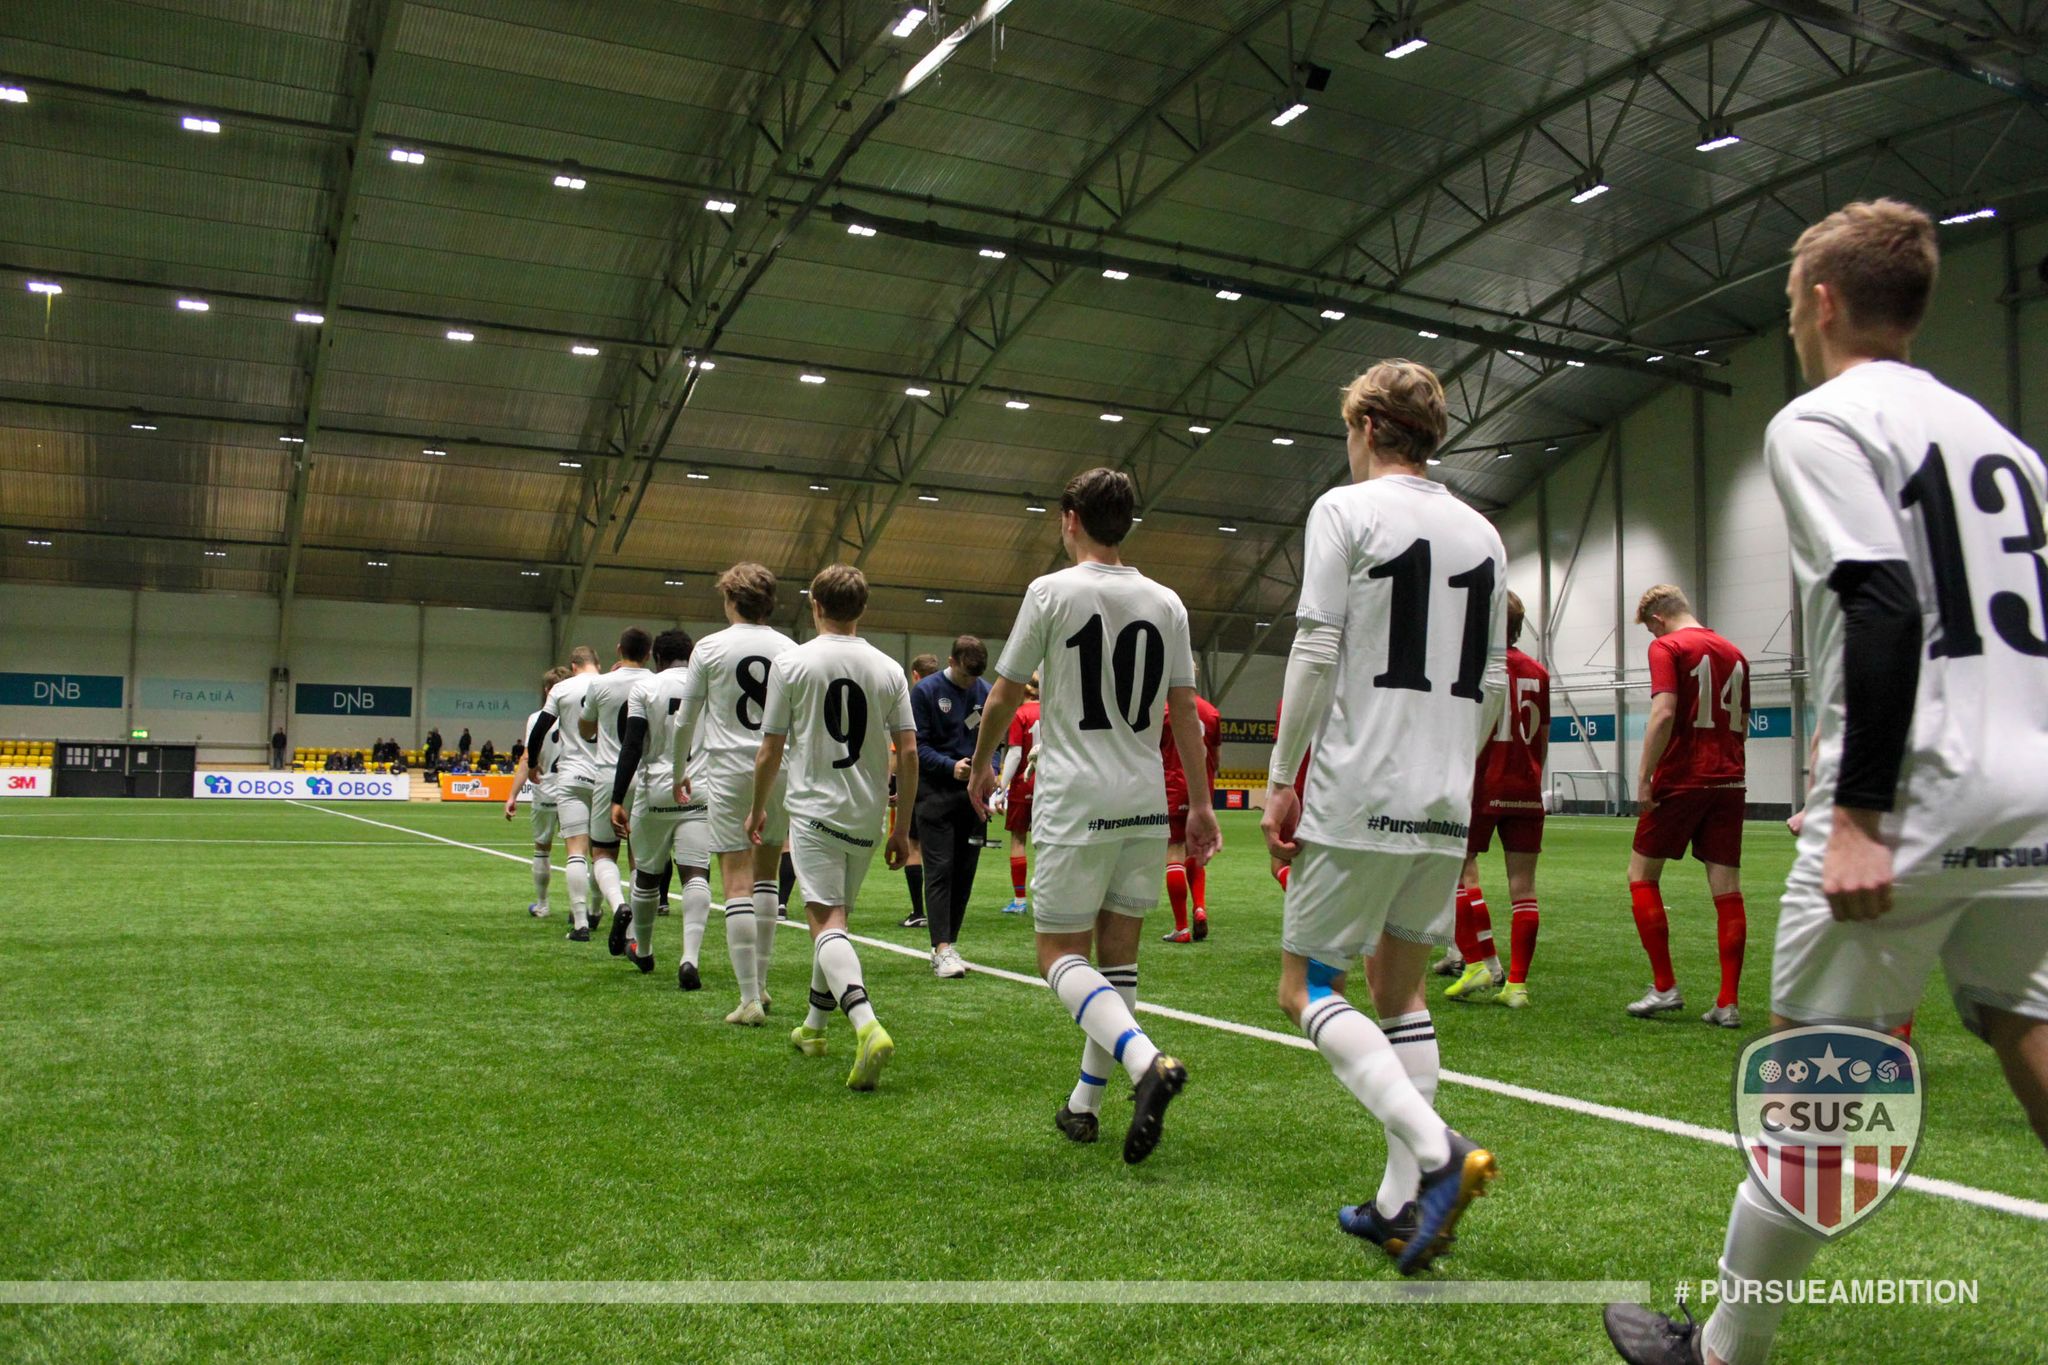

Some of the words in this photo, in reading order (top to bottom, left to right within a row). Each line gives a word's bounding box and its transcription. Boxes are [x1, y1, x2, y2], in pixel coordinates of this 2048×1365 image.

[1900, 442, 2048, 658] 13
[1369, 538, 1495, 703] 11
[1066, 613, 1164, 733] 10
[34, 677, 81, 704] DNB
[173, 689, 193, 700] Fra
[196, 690, 206, 700] A
[209, 690, 222, 702] til
[333, 687, 374, 713] DNB
[736, 655, 771, 731] 8
[1690, 654, 1744, 732] 14
[456, 699, 473, 709] Fra
[477, 699, 485, 710] A
[1493, 673, 1541, 745] 15
[824, 678, 868, 769] 9
[1748, 710, 1769, 736] NB
[8, 776, 37, 789] 3M
[237, 780, 294, 795] OBOS
[338, 782, 392, 796] OBOS
[1941, 843, 2048, 869] #Pursue
